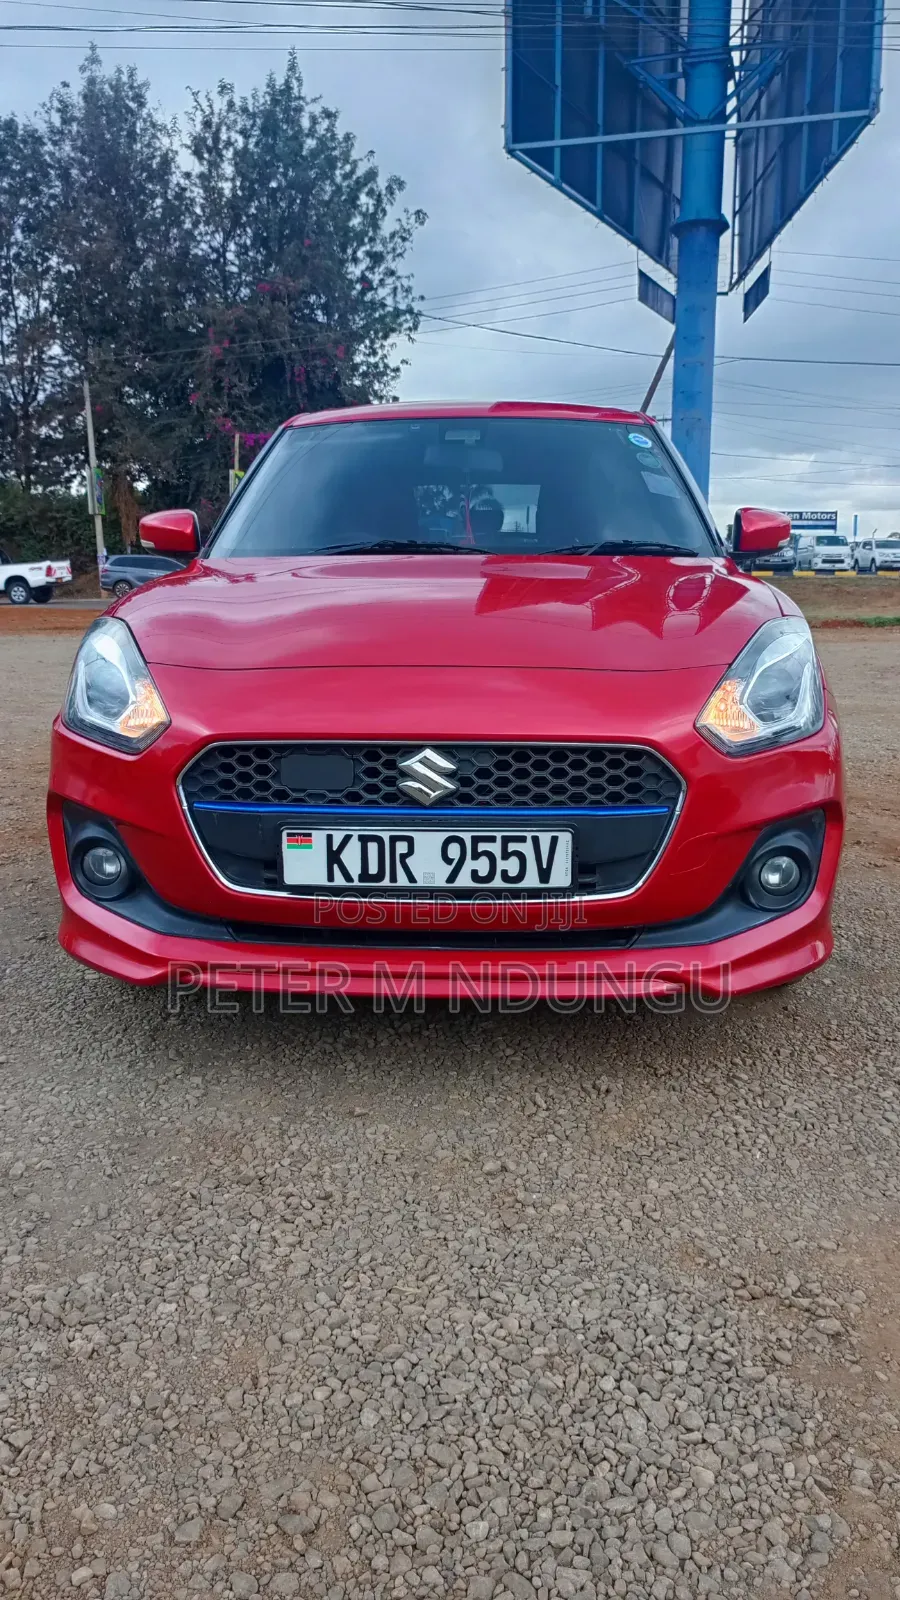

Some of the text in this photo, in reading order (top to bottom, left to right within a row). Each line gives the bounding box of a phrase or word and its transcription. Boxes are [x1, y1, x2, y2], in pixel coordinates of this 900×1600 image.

[801, 511, 836, 520] Motors
[326, 834, 418, 884] KDR
[441, 835, 559, 884] 955V
